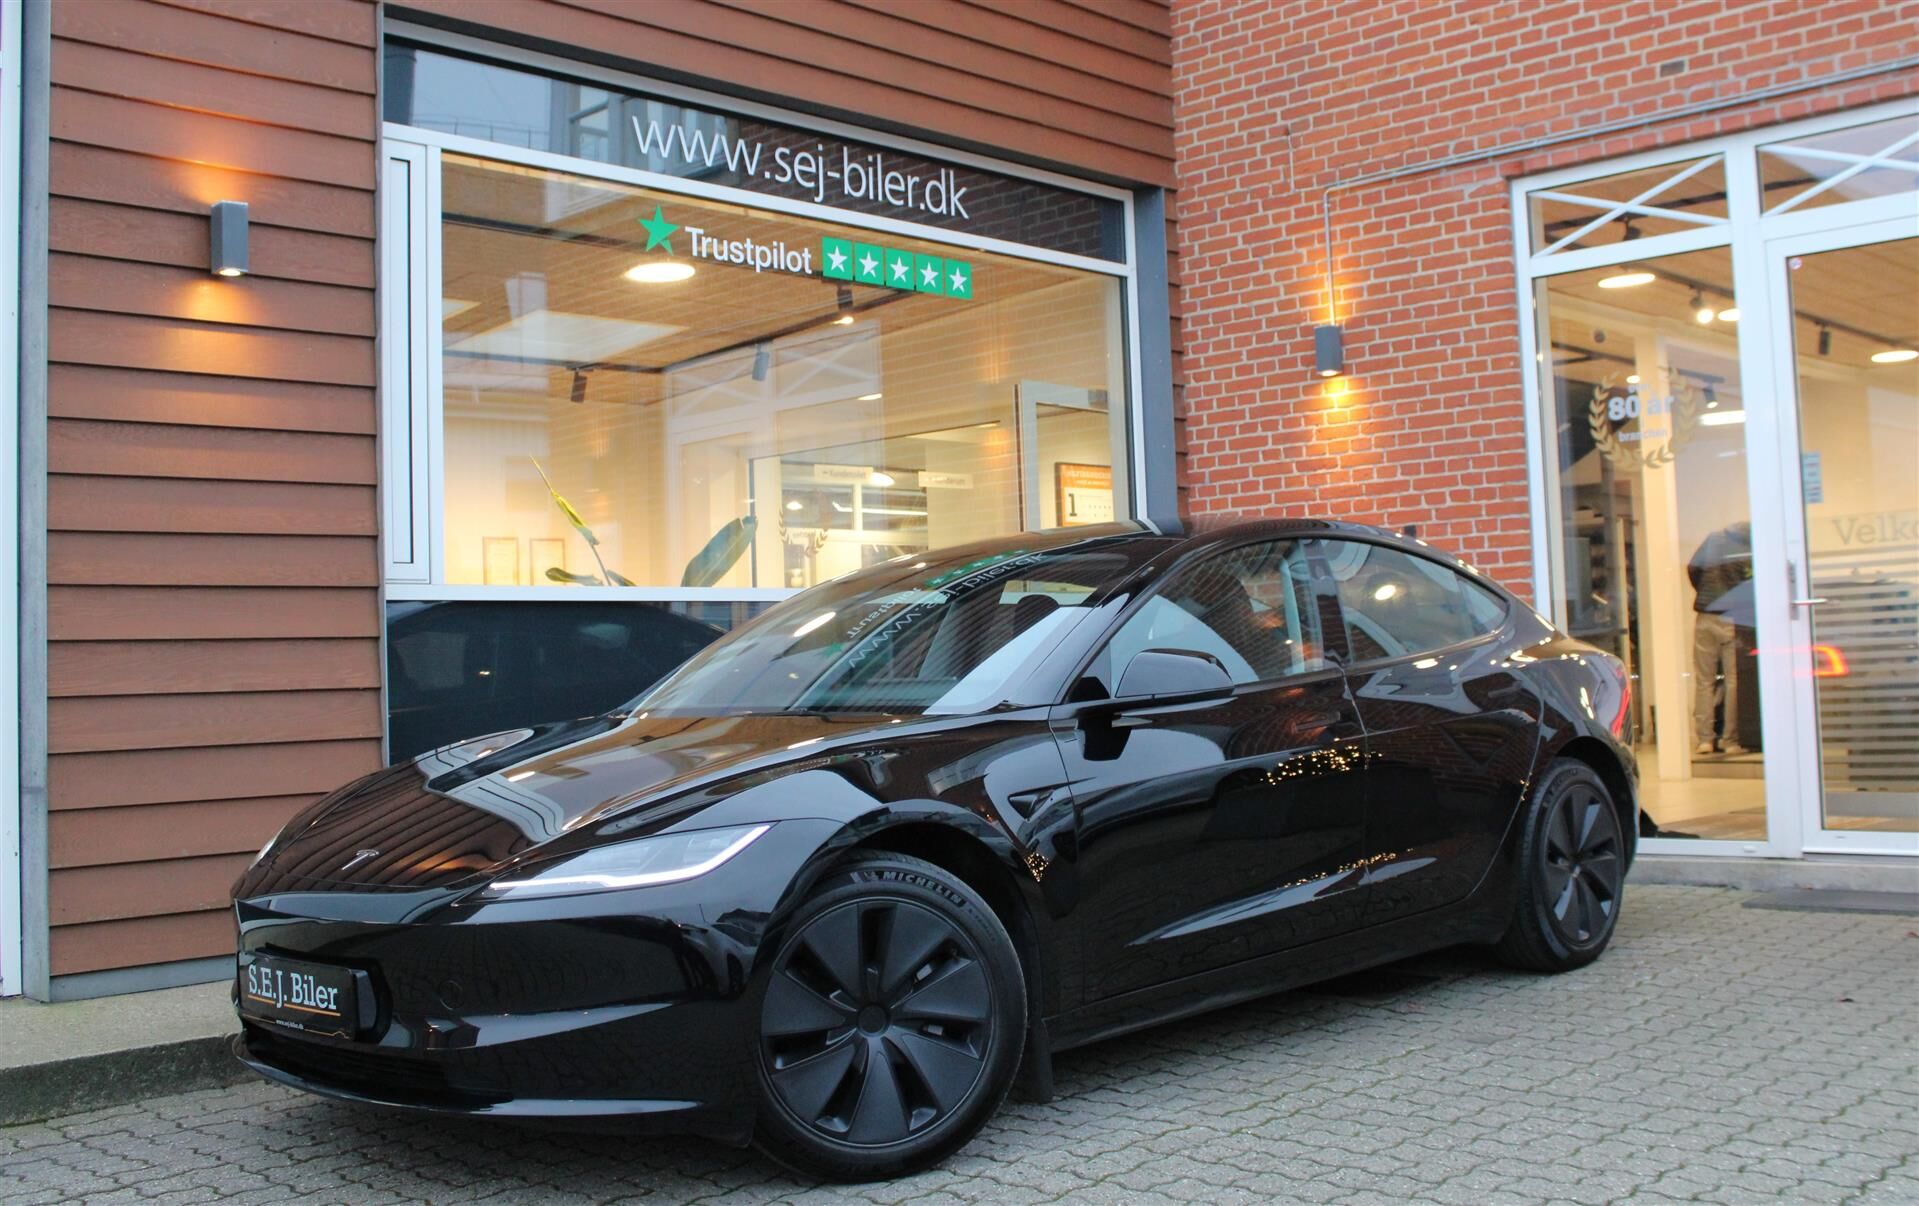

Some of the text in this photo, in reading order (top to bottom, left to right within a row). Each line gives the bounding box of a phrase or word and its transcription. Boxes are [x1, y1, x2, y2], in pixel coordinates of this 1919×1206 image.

[631, 115, 970, 220] www.sej-biler.dk
[685, 226, 813, 274] Trustpilot
[1608, 391, 1676, 421] 80 år
[882, 871, 964, 907] MICHELIN
[248, 964, 338, 1010] S.E.J. Biler
